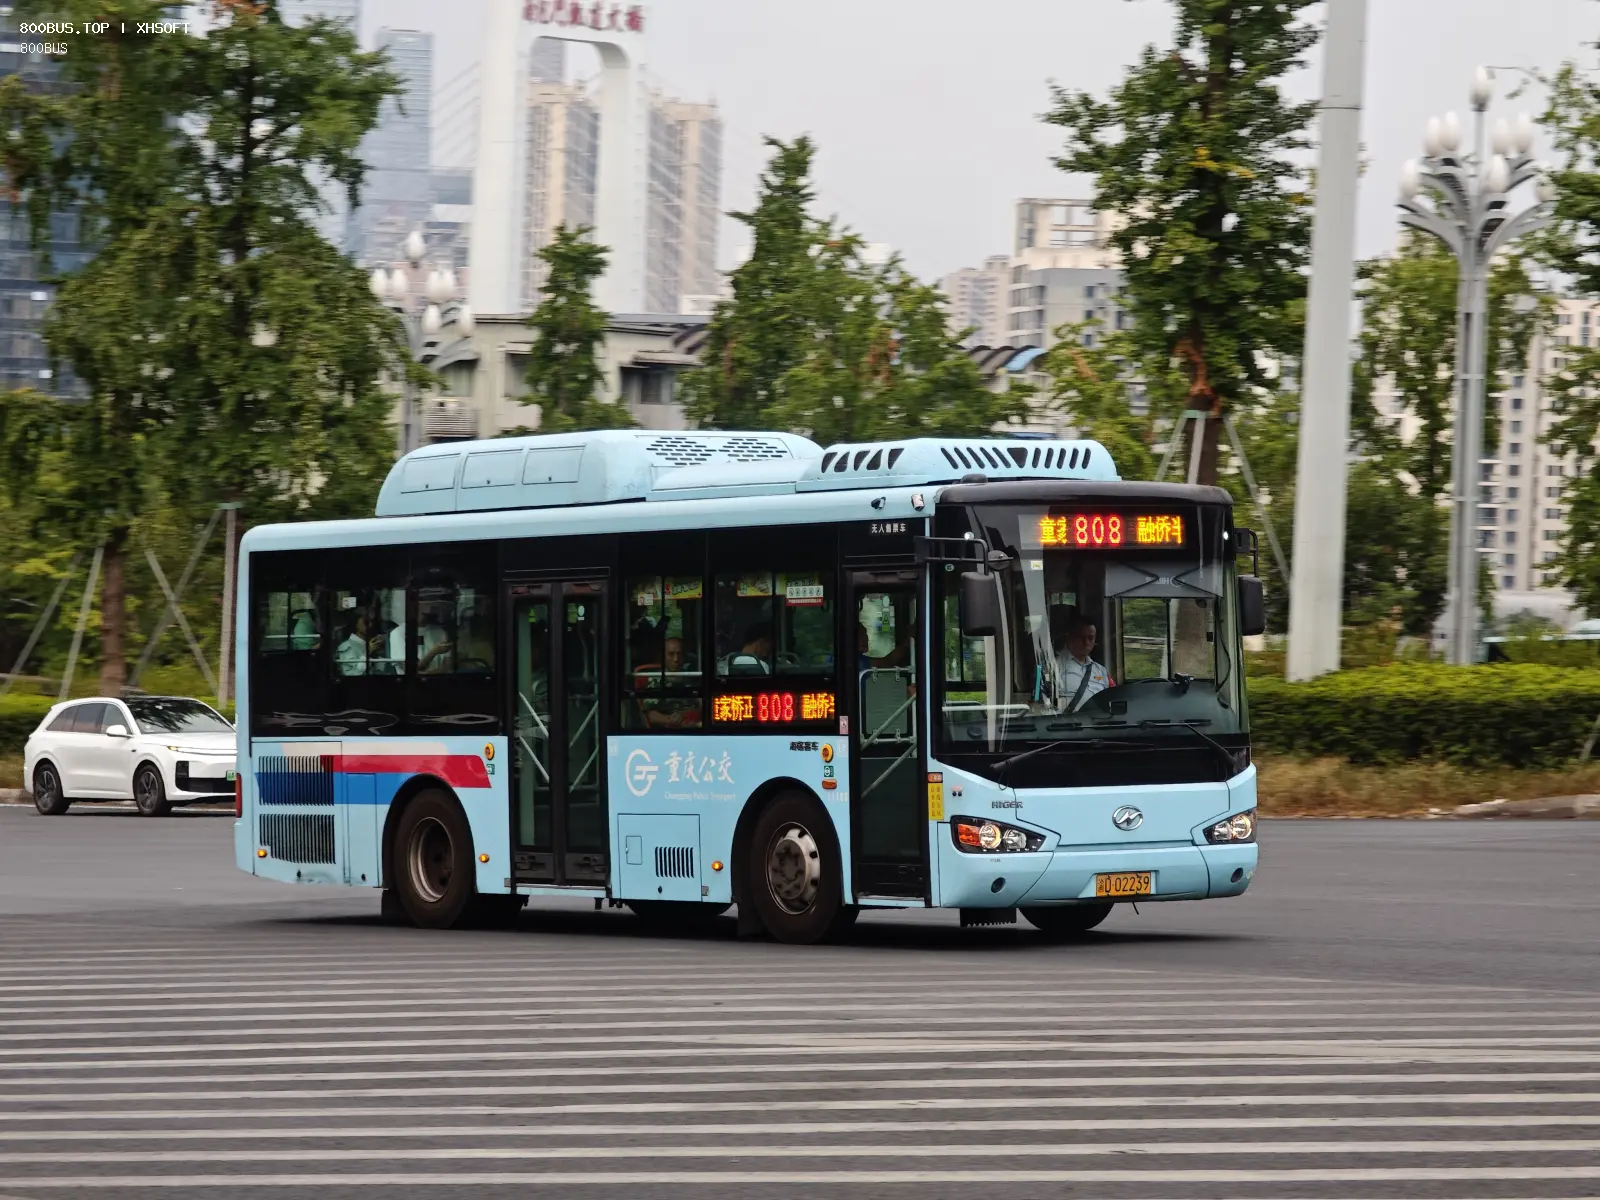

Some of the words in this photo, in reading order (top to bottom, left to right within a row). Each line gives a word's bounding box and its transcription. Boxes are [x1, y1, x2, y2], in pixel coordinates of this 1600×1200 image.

[871, 523, 906, 533] 无人售票车
[1075, 516, 1121, 544] 808
[759, 694, 794, 721] 808
[664, 750, 735, 784] 重庆公交
[991, 801, 1023, 809] HIGER
